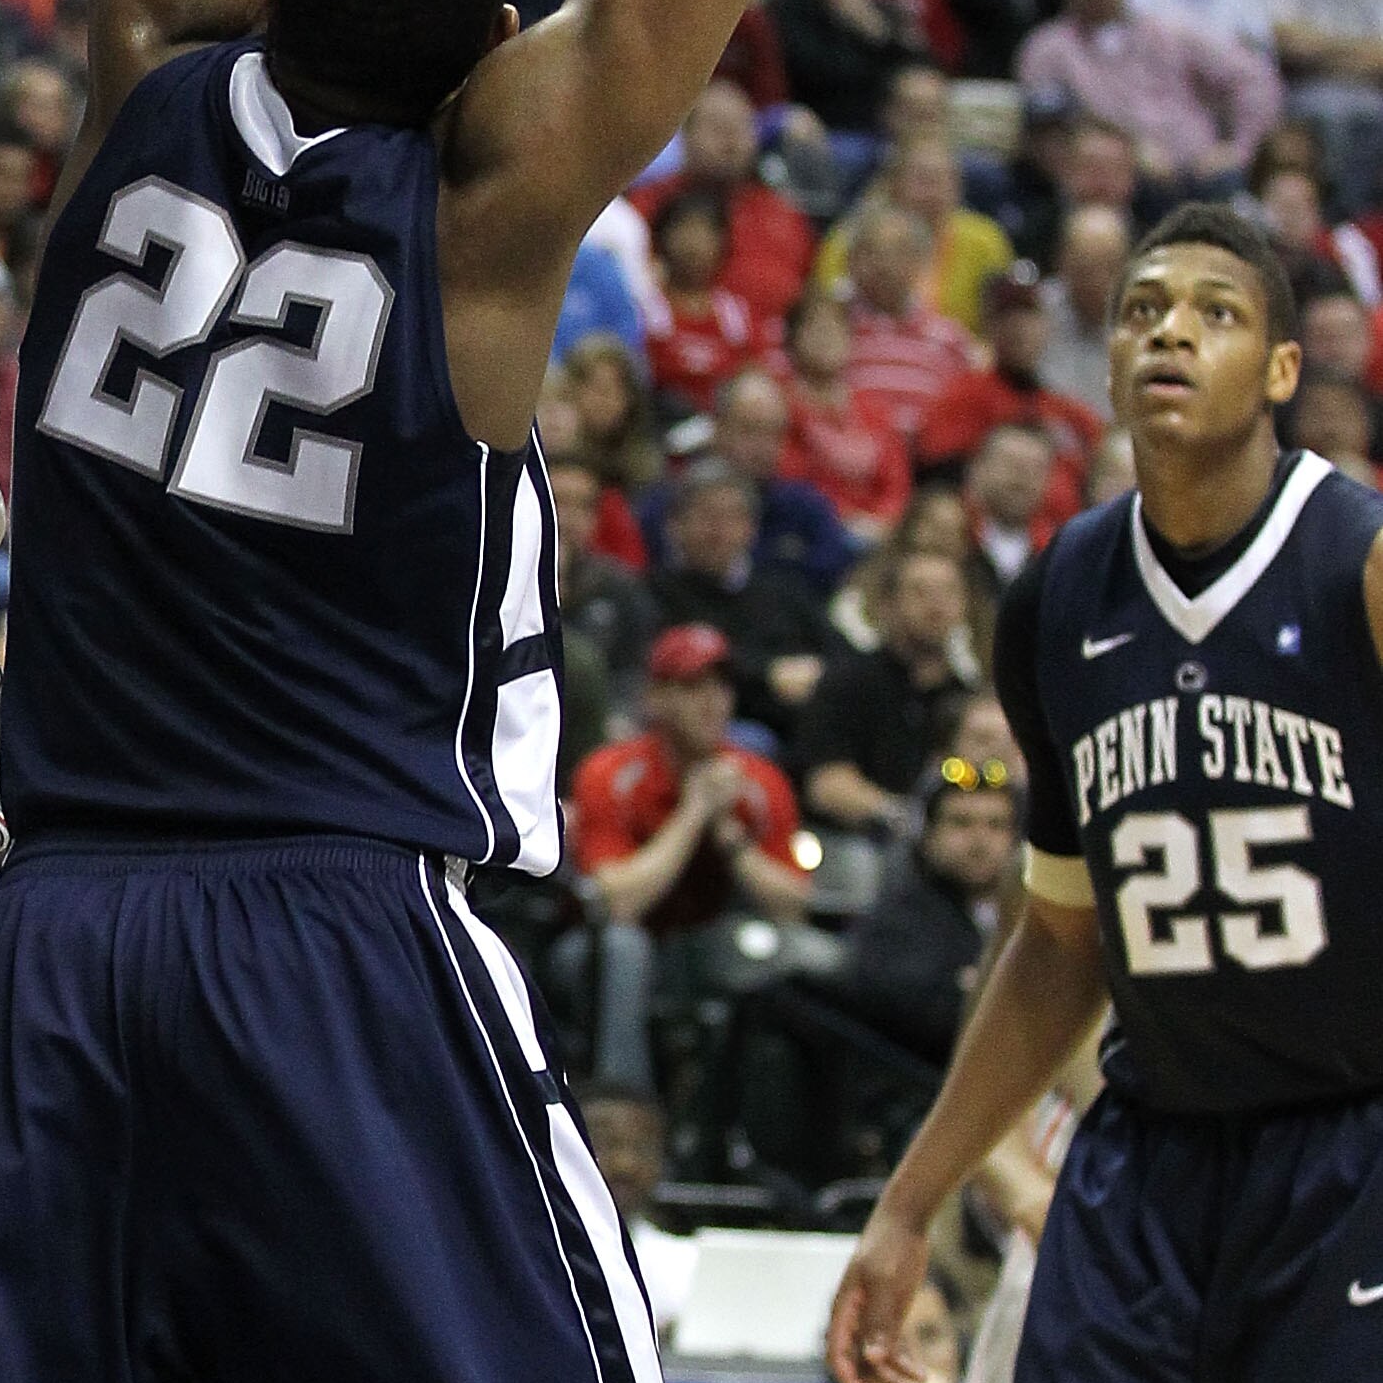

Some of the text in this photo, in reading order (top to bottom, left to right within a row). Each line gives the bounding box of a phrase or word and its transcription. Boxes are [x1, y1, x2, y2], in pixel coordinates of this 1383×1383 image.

[35, 174, 396, 535] 22
[1073, 693, 1354, 827] PENN STATE
[1111, 804, 1328, 977] 25
